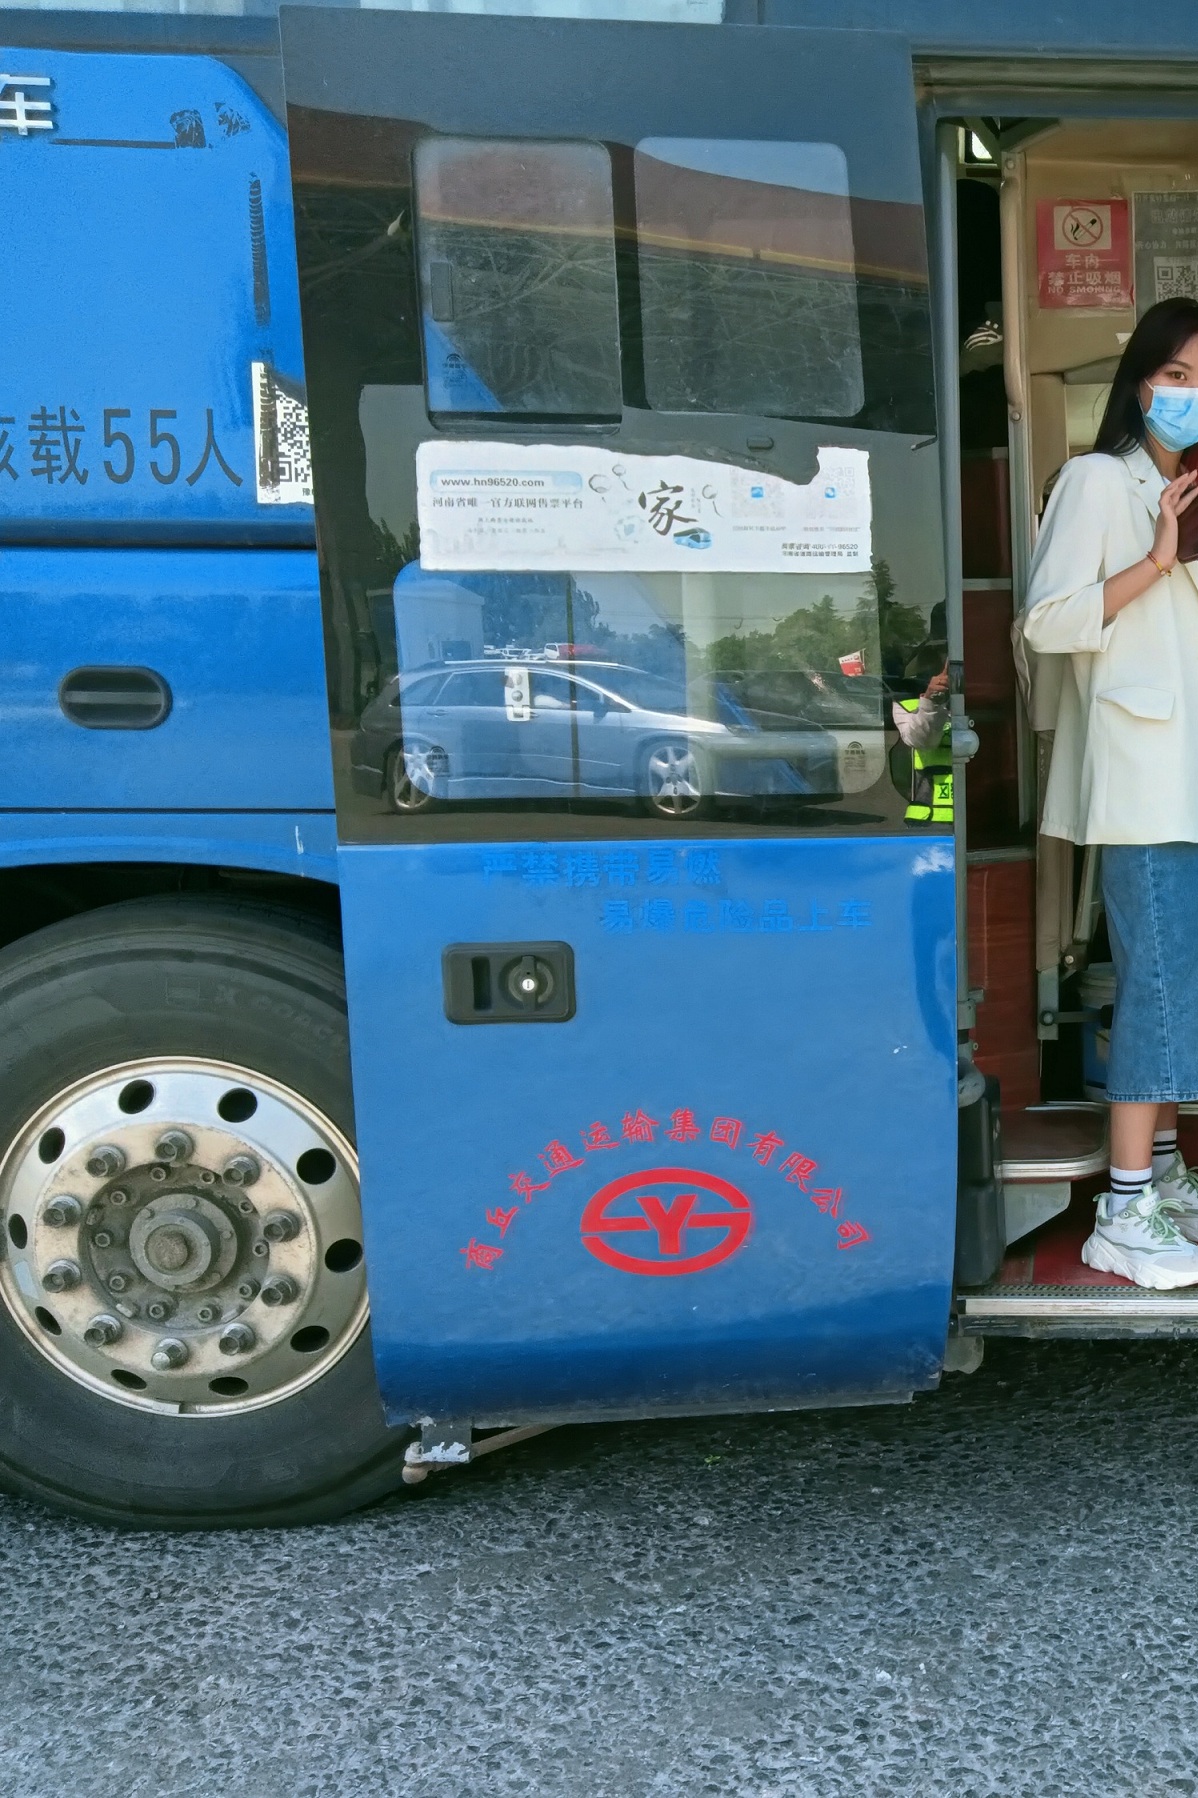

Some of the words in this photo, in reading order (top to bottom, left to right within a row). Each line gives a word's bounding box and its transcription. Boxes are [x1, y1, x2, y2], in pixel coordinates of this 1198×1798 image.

[1065, 253, 1100, 269] 车内
[1047, 271, 1121, 286] 禁止吸烟
[1048, 286, 1064, 294] NO
[1069, 286, 1121, 294] SMOKING
[441, 477, 545, 487] www.hn96520.com
[432, 496, 583, 509] 河南省唯一官方联网售票平台
[638, 479, 698, 536] 家
[480, 849, 721, 888] 严禁携带易燃
[599, 897, 873, 935] 易爆危险品上车
[459, 1107, 871, 1270] 商丘交通运输集团有限公司
